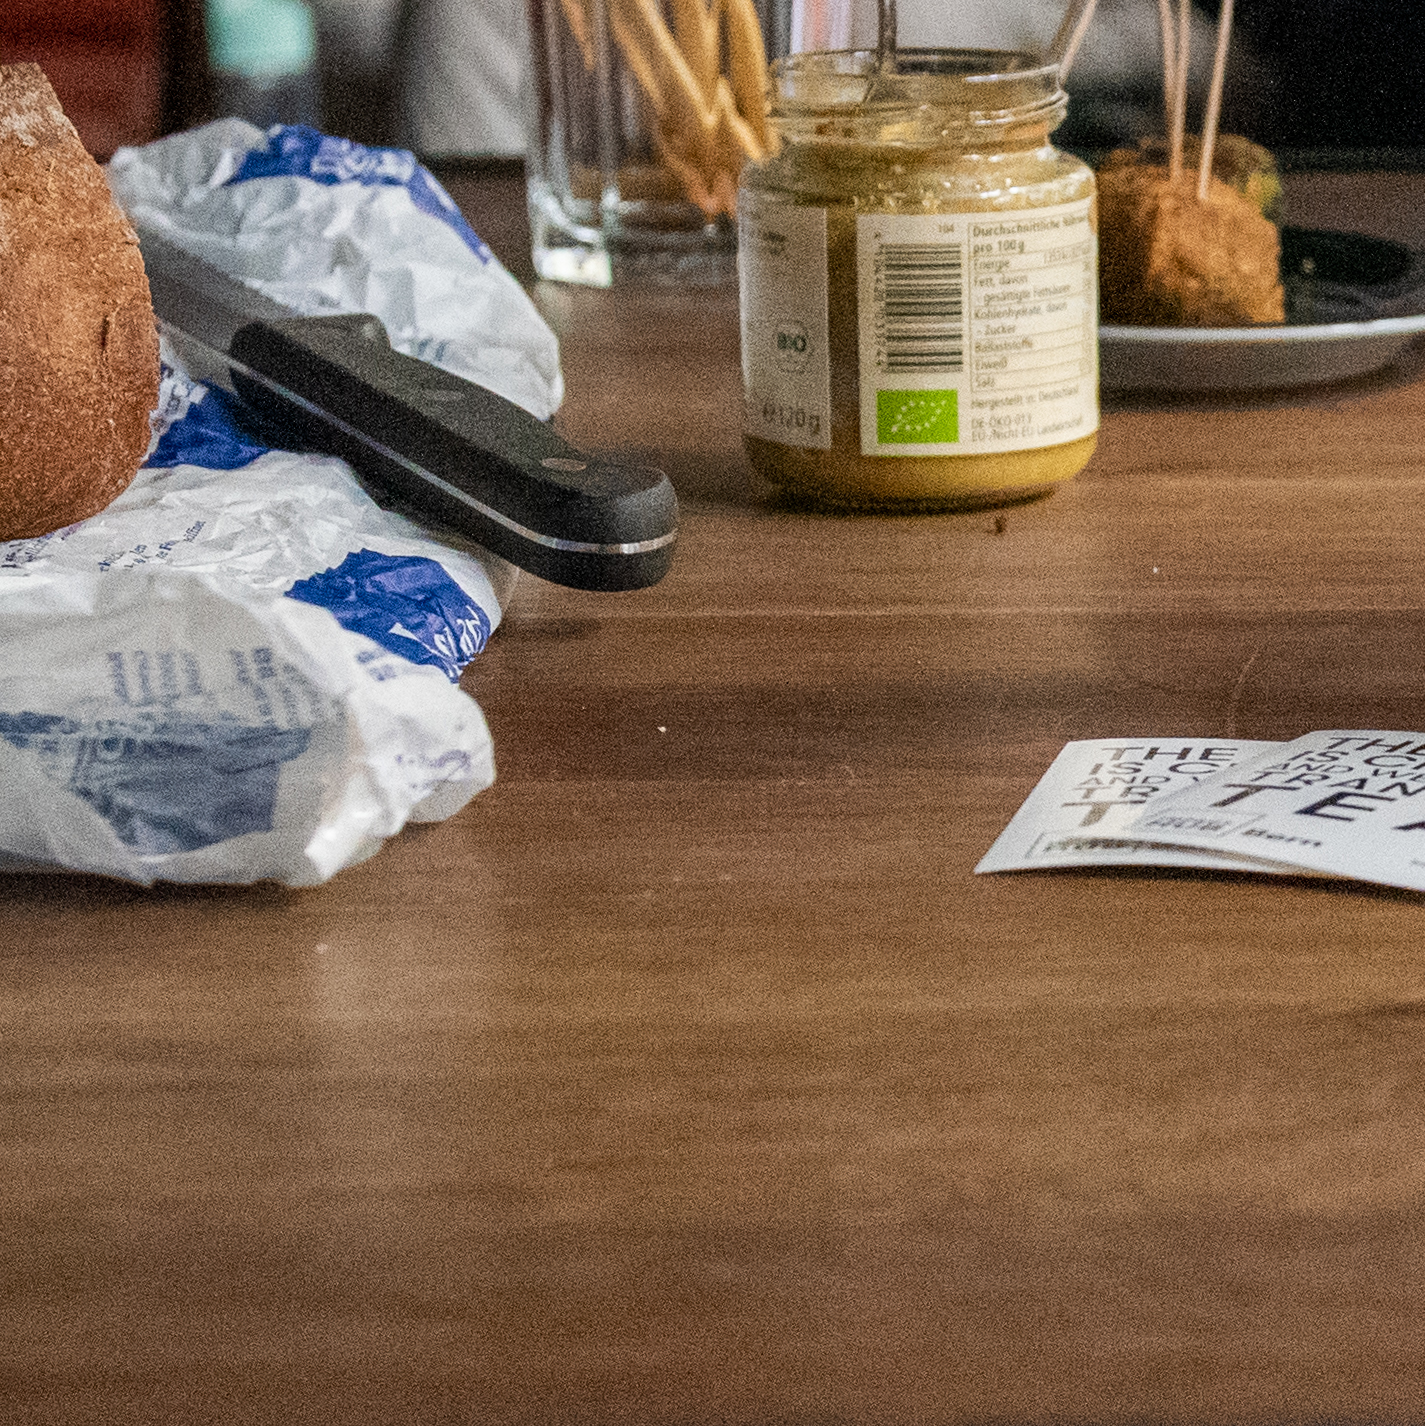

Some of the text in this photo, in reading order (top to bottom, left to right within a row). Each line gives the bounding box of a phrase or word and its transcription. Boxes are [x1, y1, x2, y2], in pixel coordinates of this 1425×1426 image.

[776, 331, 807, 353] BIO
[1100, 745, 1239, 762] THE
[1287, 750, 1350, 763] IS
[1088, 761, 1144, 775] IS
[1255, 761, 1354, 774] AND
[1078, 775, 1172, 786] AND
